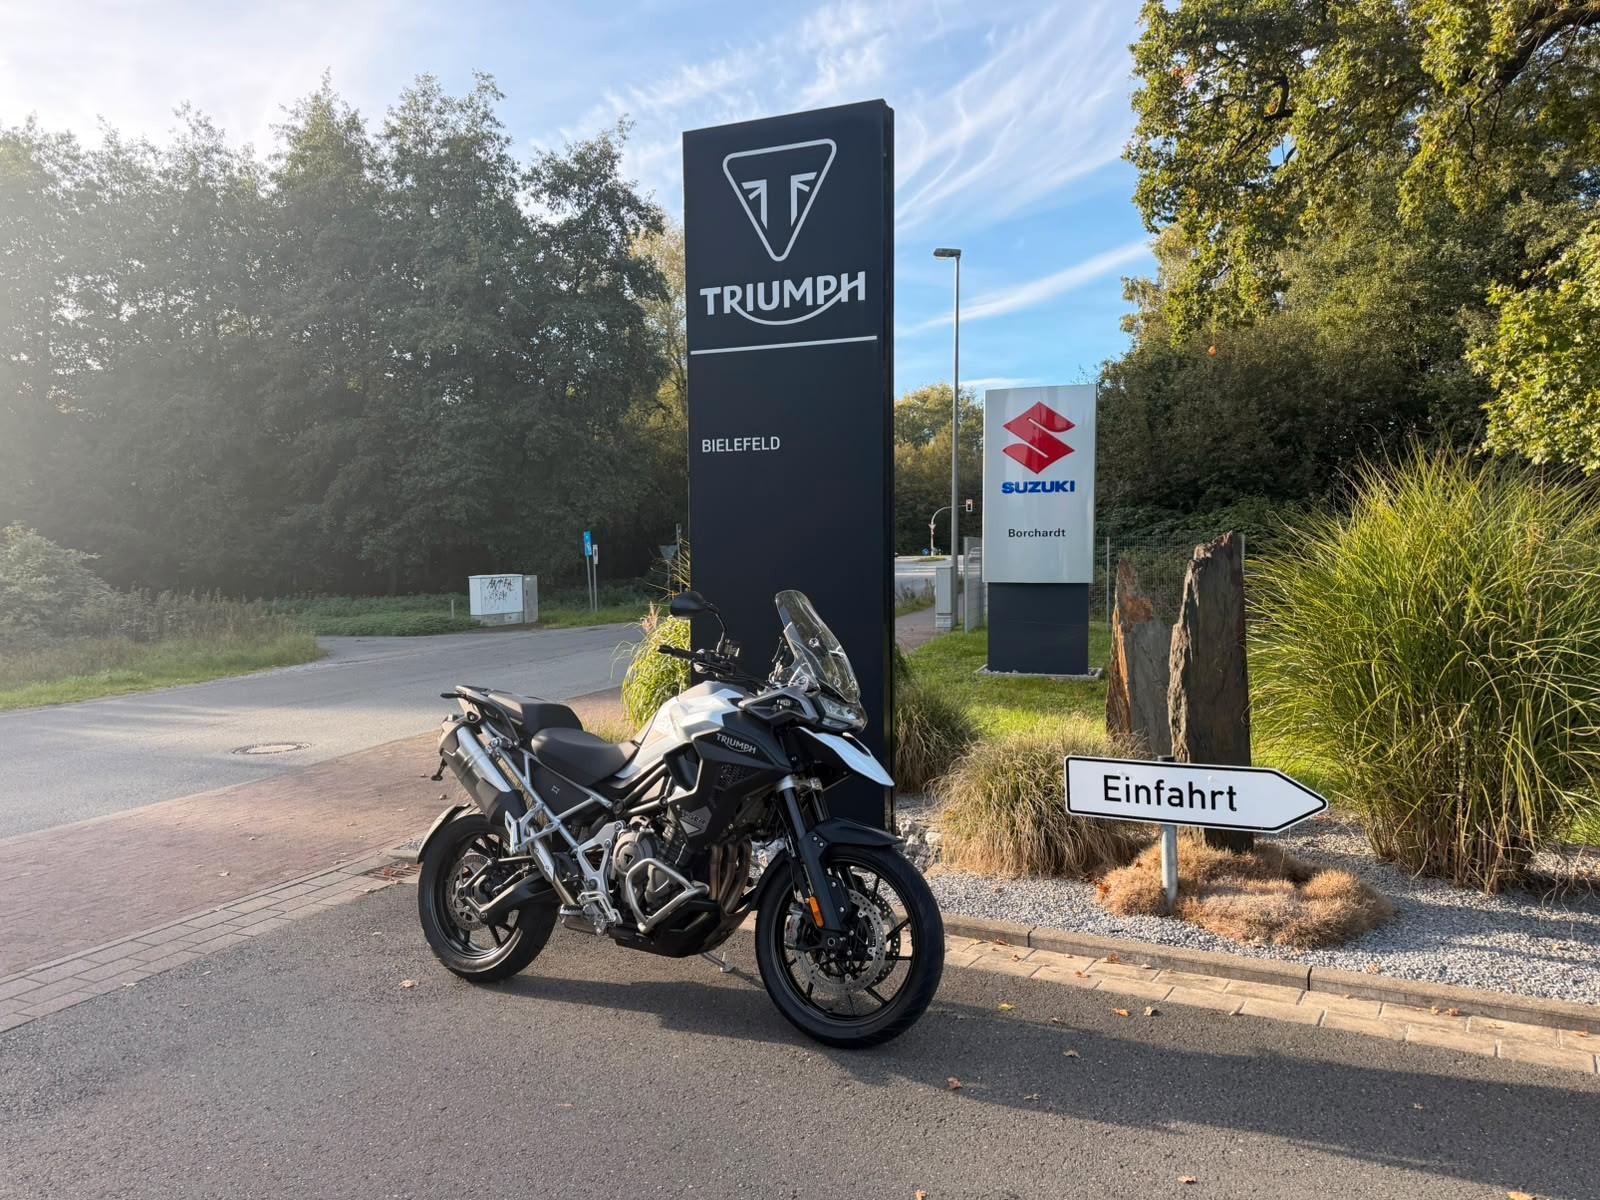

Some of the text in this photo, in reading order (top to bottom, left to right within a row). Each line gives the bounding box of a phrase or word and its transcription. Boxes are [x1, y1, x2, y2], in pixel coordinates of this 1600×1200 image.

[700, 271, 866, 326] TRIUMPH
[701, 436, 781, 453] BIELEFELD
[1001, 480, 1076, 494] SUZUKI
[1008, 528, 1066, 538] Borchardt
[716, 732, 757, 754] TRIUMPH
[1103, 775, 1237, 812] Einfahrt
